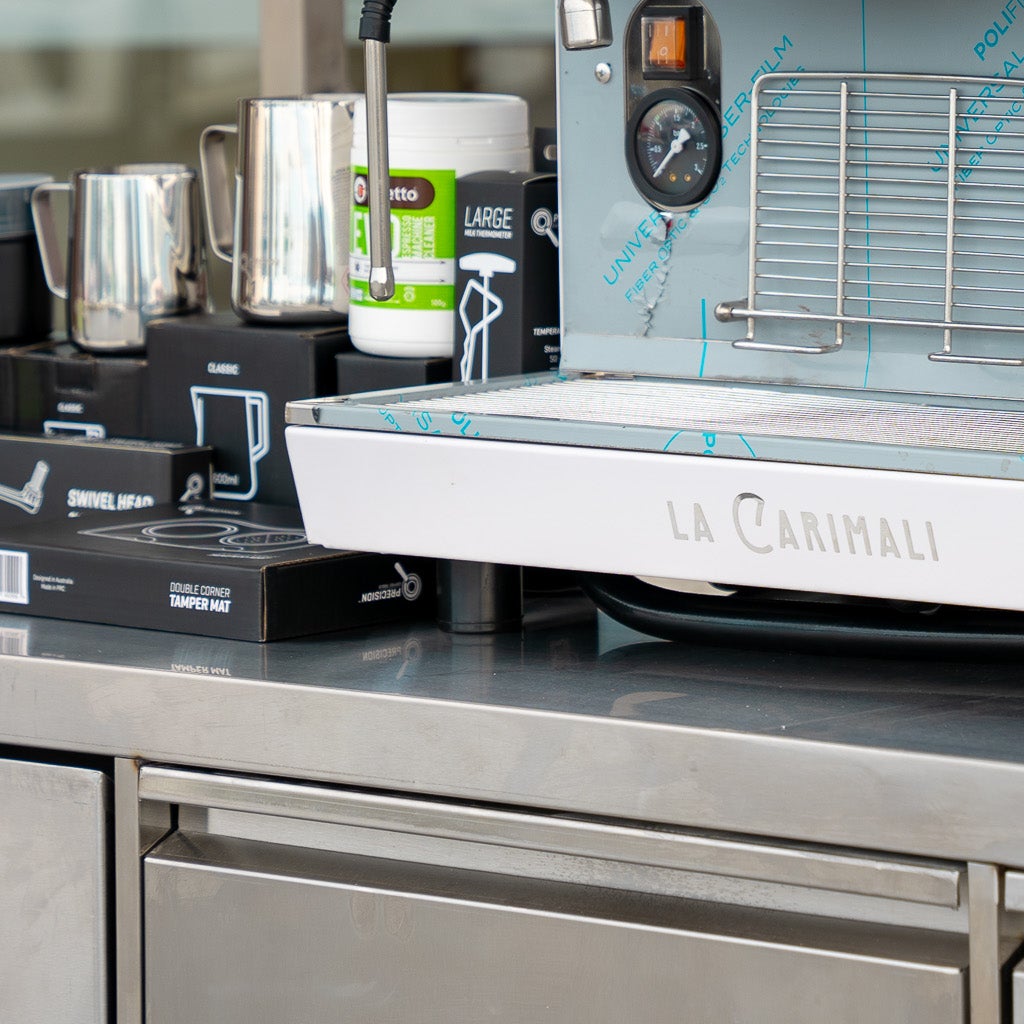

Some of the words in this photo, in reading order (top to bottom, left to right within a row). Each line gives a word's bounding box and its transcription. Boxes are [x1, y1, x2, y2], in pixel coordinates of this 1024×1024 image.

[464, 206, 513, 230] LARGE
[624, 259, 659, 303] FIBER
[67, 488, 116, 511] SWIVEL
[666, 500, 715, 542] LA
[732, 492, 939, 561] CARIMALI
[170, 582, 199, 596] DOUBLE
[200, 585, 231, 598] CORNER
[169, 594, 208, 611] TAMPER
[209, 599, 231, 613] MAT
